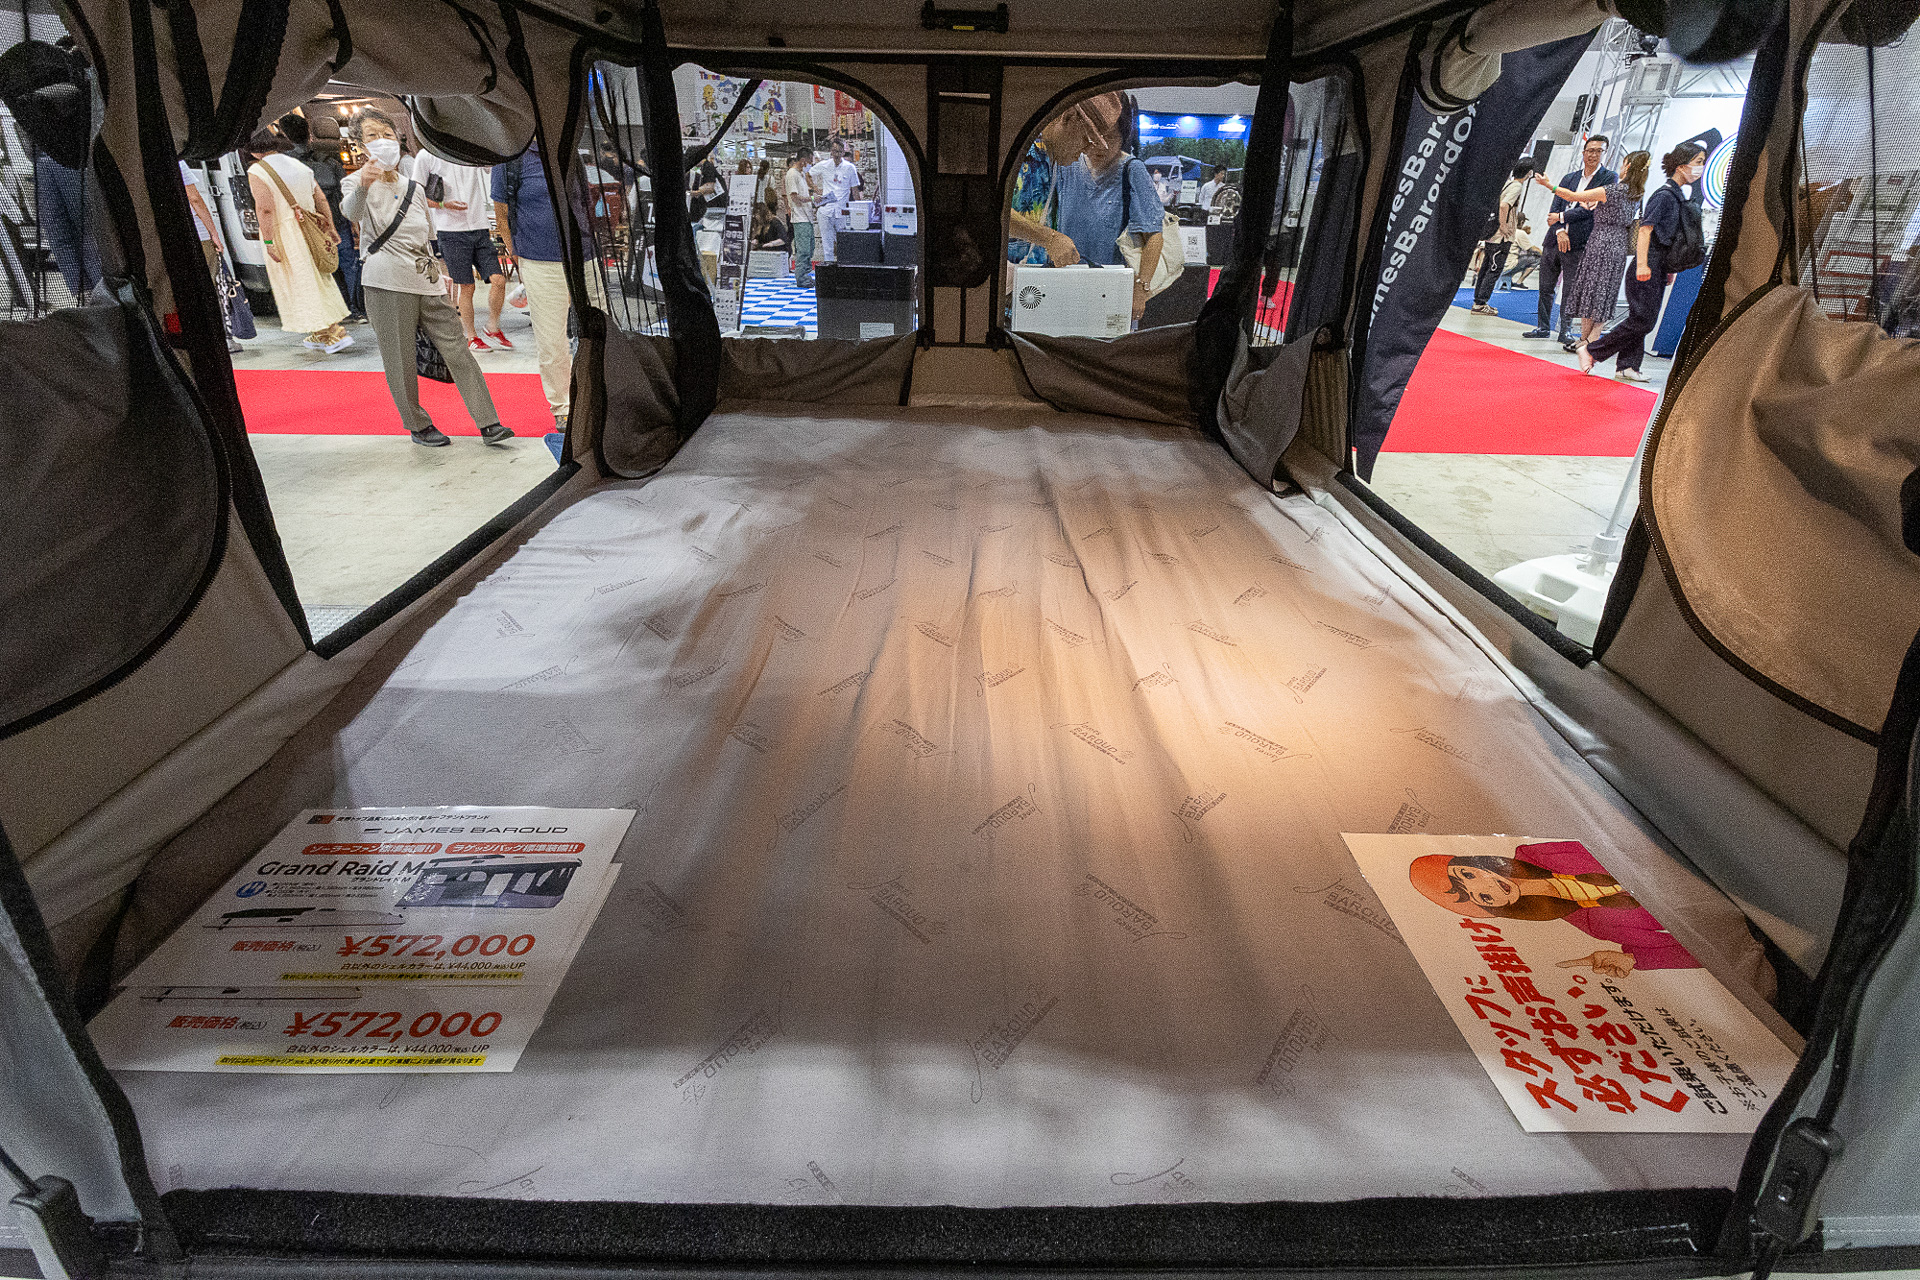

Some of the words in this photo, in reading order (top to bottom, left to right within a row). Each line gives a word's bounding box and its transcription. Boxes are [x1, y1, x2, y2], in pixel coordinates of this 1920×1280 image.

[257, 860, 340, 876] Grand
[336, 860, 398, 876] Raid
[397, 861, 428, 876] M
[384, 826, 463, 835] JAMES
[470, 826, 568, 834] BAROUD
[335, 933, 537, 961] ¥572,000
[282, 1011, 503, 1043] ¥572,000
[1458, 917, 1638, 1115] 必ずお声掛け
[1463, 974, 1579, 1114] スタッフに
[1566, 974, 1691, 1113] ください。
[1600, 977, 1729, 1115] ご試乗いただけます。
